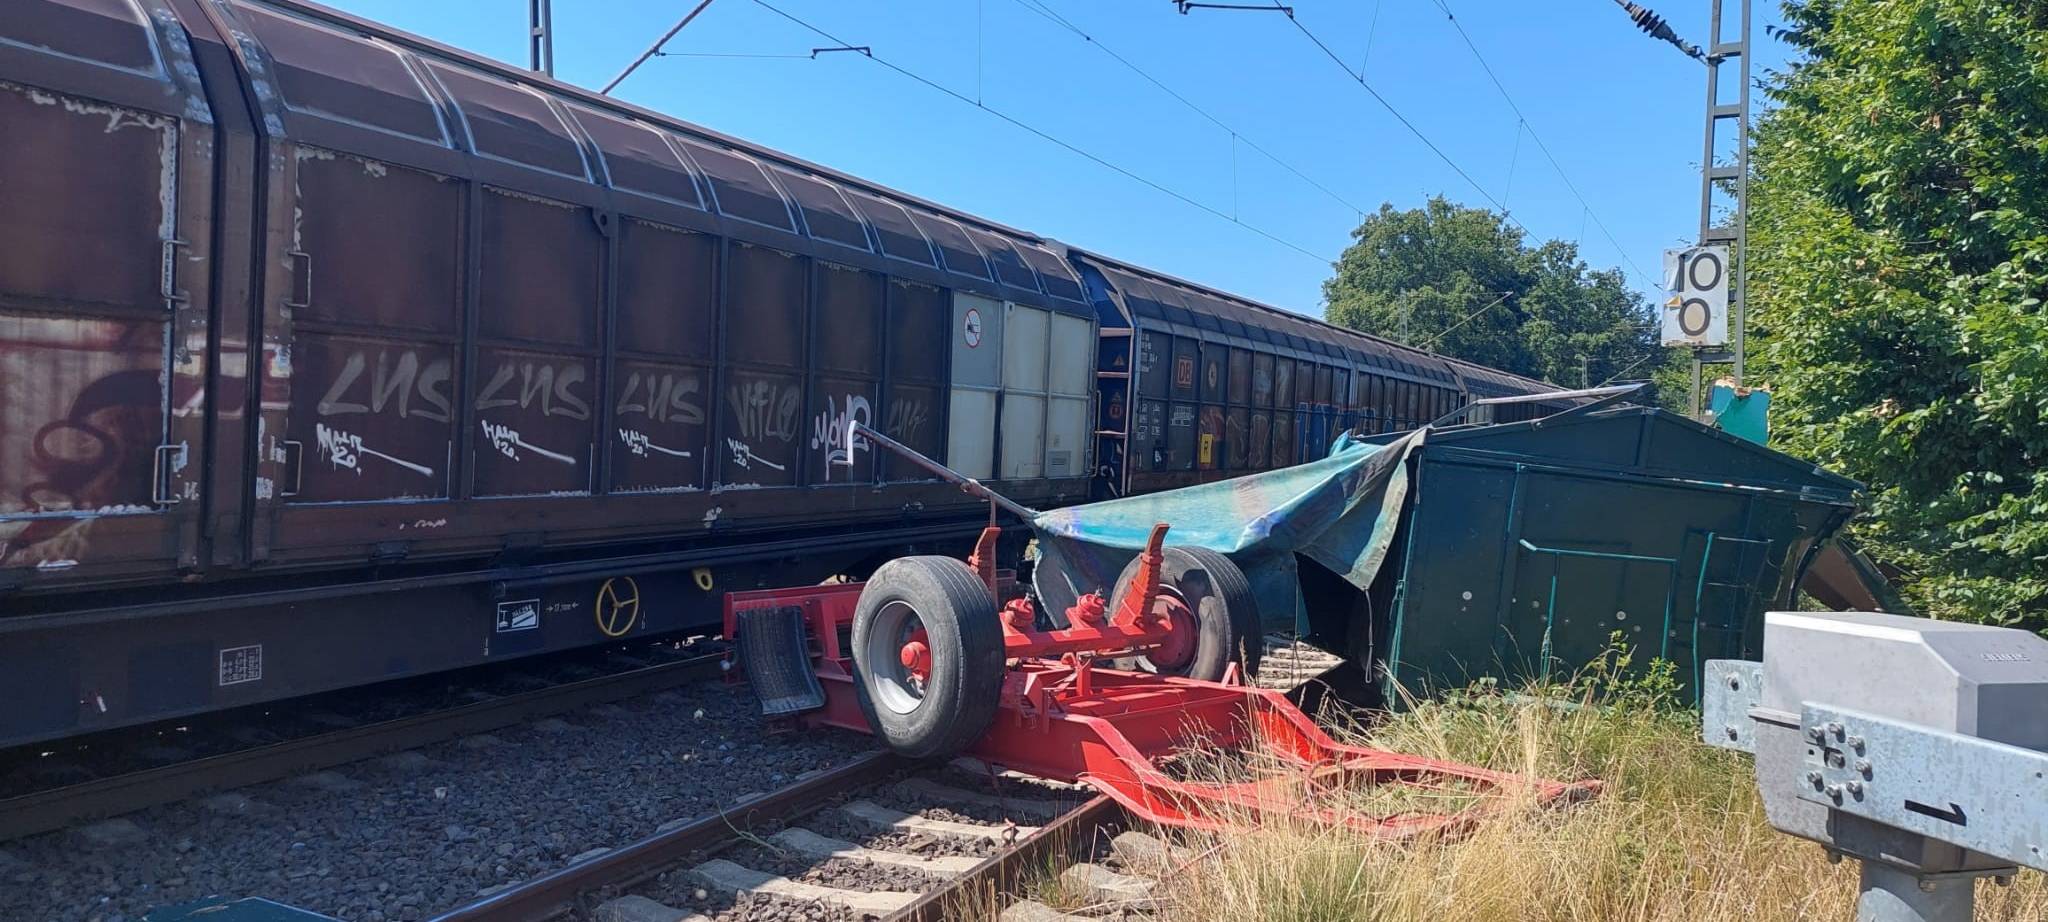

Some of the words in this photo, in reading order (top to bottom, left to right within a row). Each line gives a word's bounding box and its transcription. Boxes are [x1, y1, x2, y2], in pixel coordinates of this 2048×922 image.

[1678, 252, 1722, 291] 10
[1679, 298, 1711, 336] 0
[1178, 361, 1193, 383] DB
